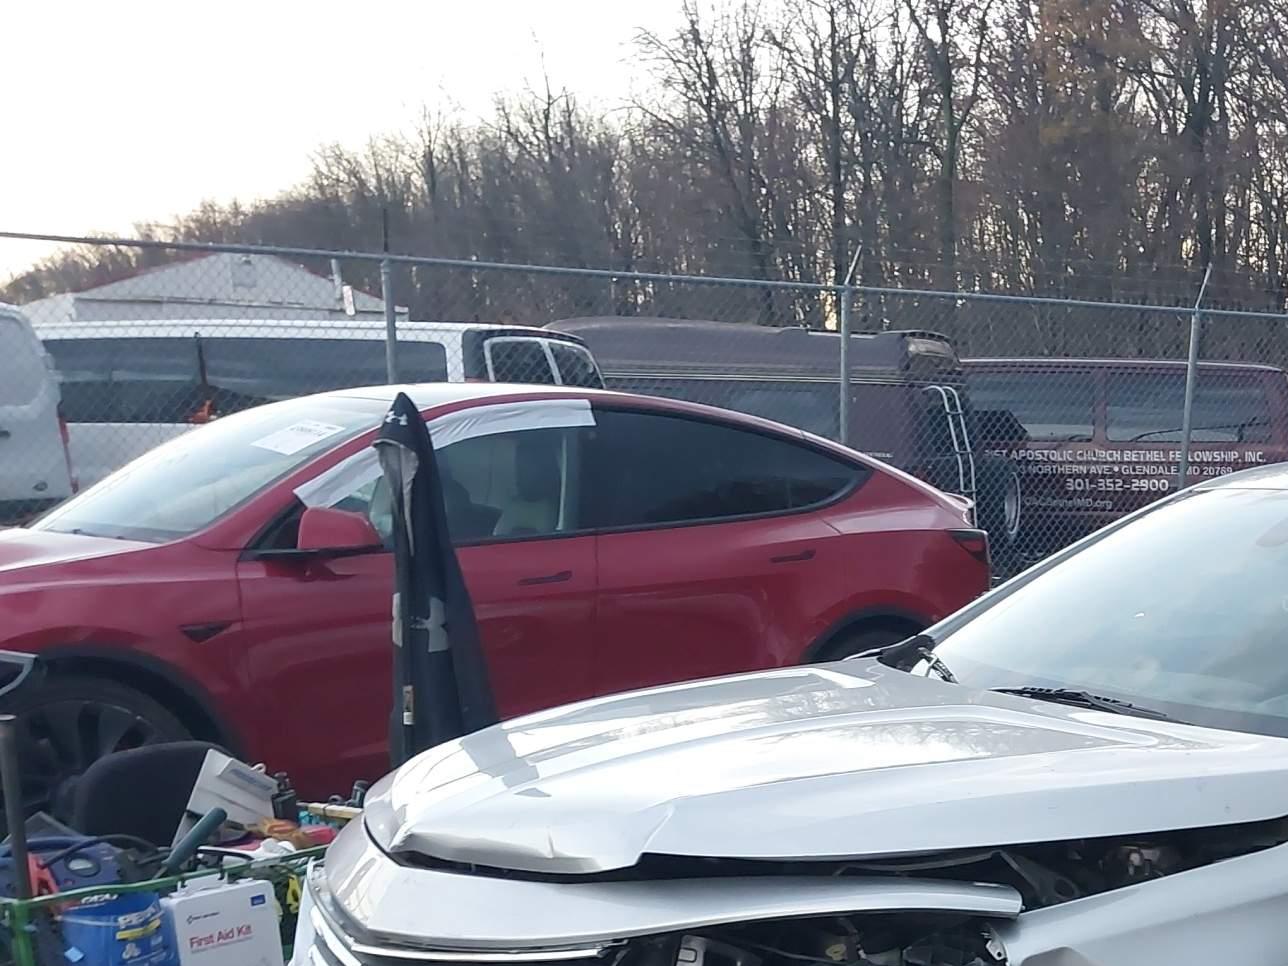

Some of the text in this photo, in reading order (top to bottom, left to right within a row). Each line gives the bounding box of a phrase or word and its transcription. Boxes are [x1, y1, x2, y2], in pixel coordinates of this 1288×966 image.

[1010, 450, 1074, 461] APOSTOLIC
[1076, 449, 1121, 461] CHURCH
[1123, 450, 1166, 461] BETHEL
[1244, 451, 1267, 462] INC.
[1029, 465, 1087, 475] NORTHERN
[1065, 479, 1169, 491] 301-352-2900
[189, 934, 215, 948] First
[217, 927, 235, 942] Aid
[237, 924, 253, 938] Kit
